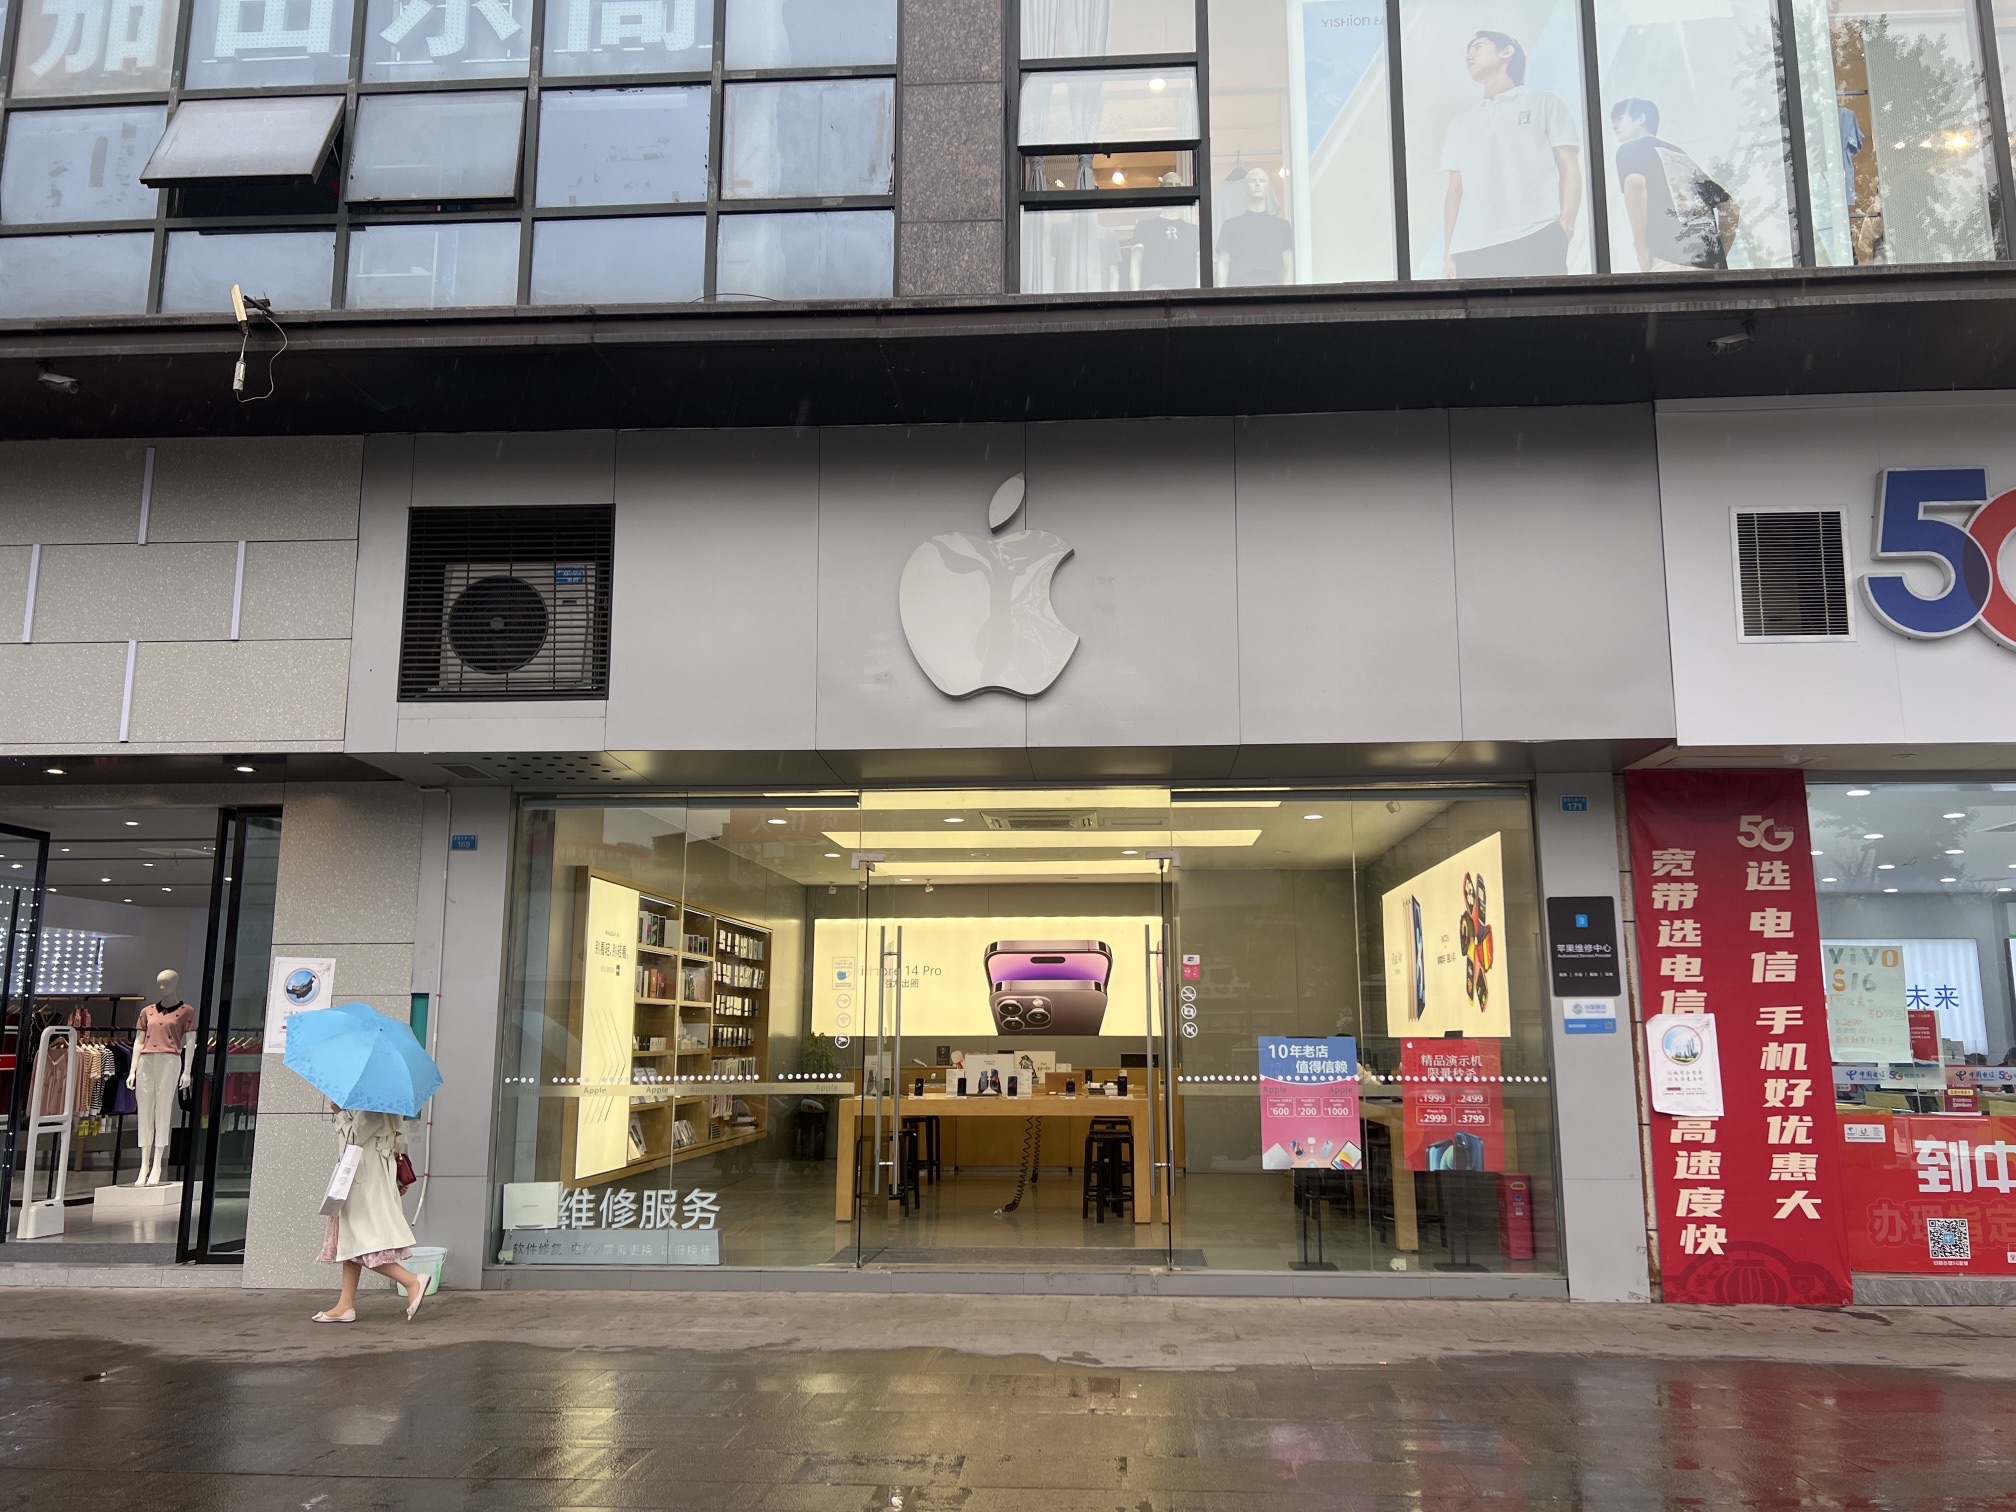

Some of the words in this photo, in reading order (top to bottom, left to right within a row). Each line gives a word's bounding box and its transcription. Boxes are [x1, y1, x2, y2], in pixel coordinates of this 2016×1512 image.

[1556, 943, 1612, 953] 苹果维修中心
[905, 965, 919, 976] 14
[923, 965, 942, 976] Pro
[1832, 968, 1877, 992] S16
[1906, 984, 1960, 1010] 未来
[1268, 1043, 1329, 1059] 10年老店
[1295, 1060, 1348, 1074] 值得信赖
[1420, 1054, 1483, 1067] 精品演示机
[1427, 1067, 1477, 1080] 限量秒杀
[583, 1086, 607, 1095] Apple
[645, 1085, 669, 1095] Apple
[1263, 1086, 1287, 1095] Apple
[1329, 1086, 1353, 1095] Apple
[558, 1187, 721, 1229] 维修服务
